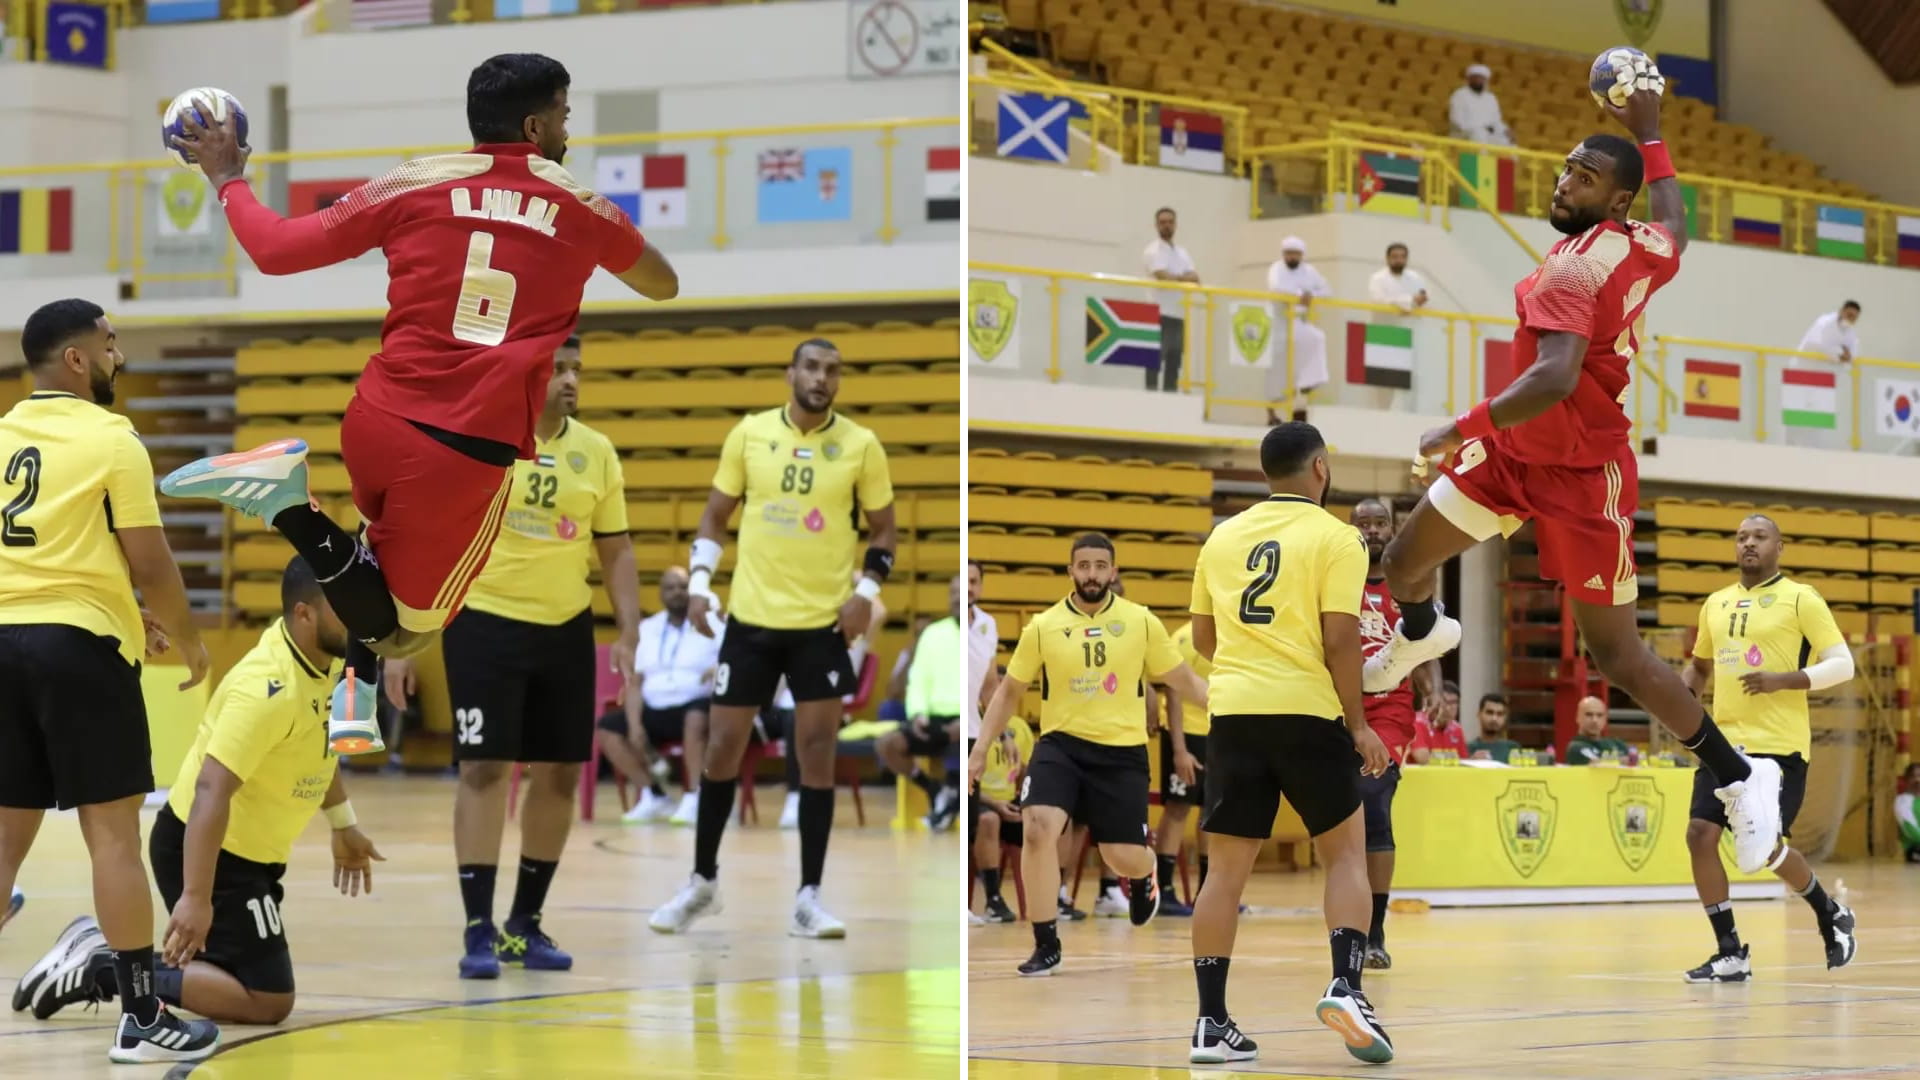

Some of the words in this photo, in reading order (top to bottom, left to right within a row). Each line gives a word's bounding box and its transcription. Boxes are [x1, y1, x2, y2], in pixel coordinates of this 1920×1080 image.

[452, 230, 517, 346] 6
[1, 446, 42, 547] 2
[523, 472, 559, 509] 32
[781, 464, 815, 495] 89
[1240, 540, 1281, 625] 2
[1729, 613, 1749, 638] 11
[1082, 641, 1107, 669] 18
[455, 707, 483, 745] 32
[246, 894, 281, 939] 10
